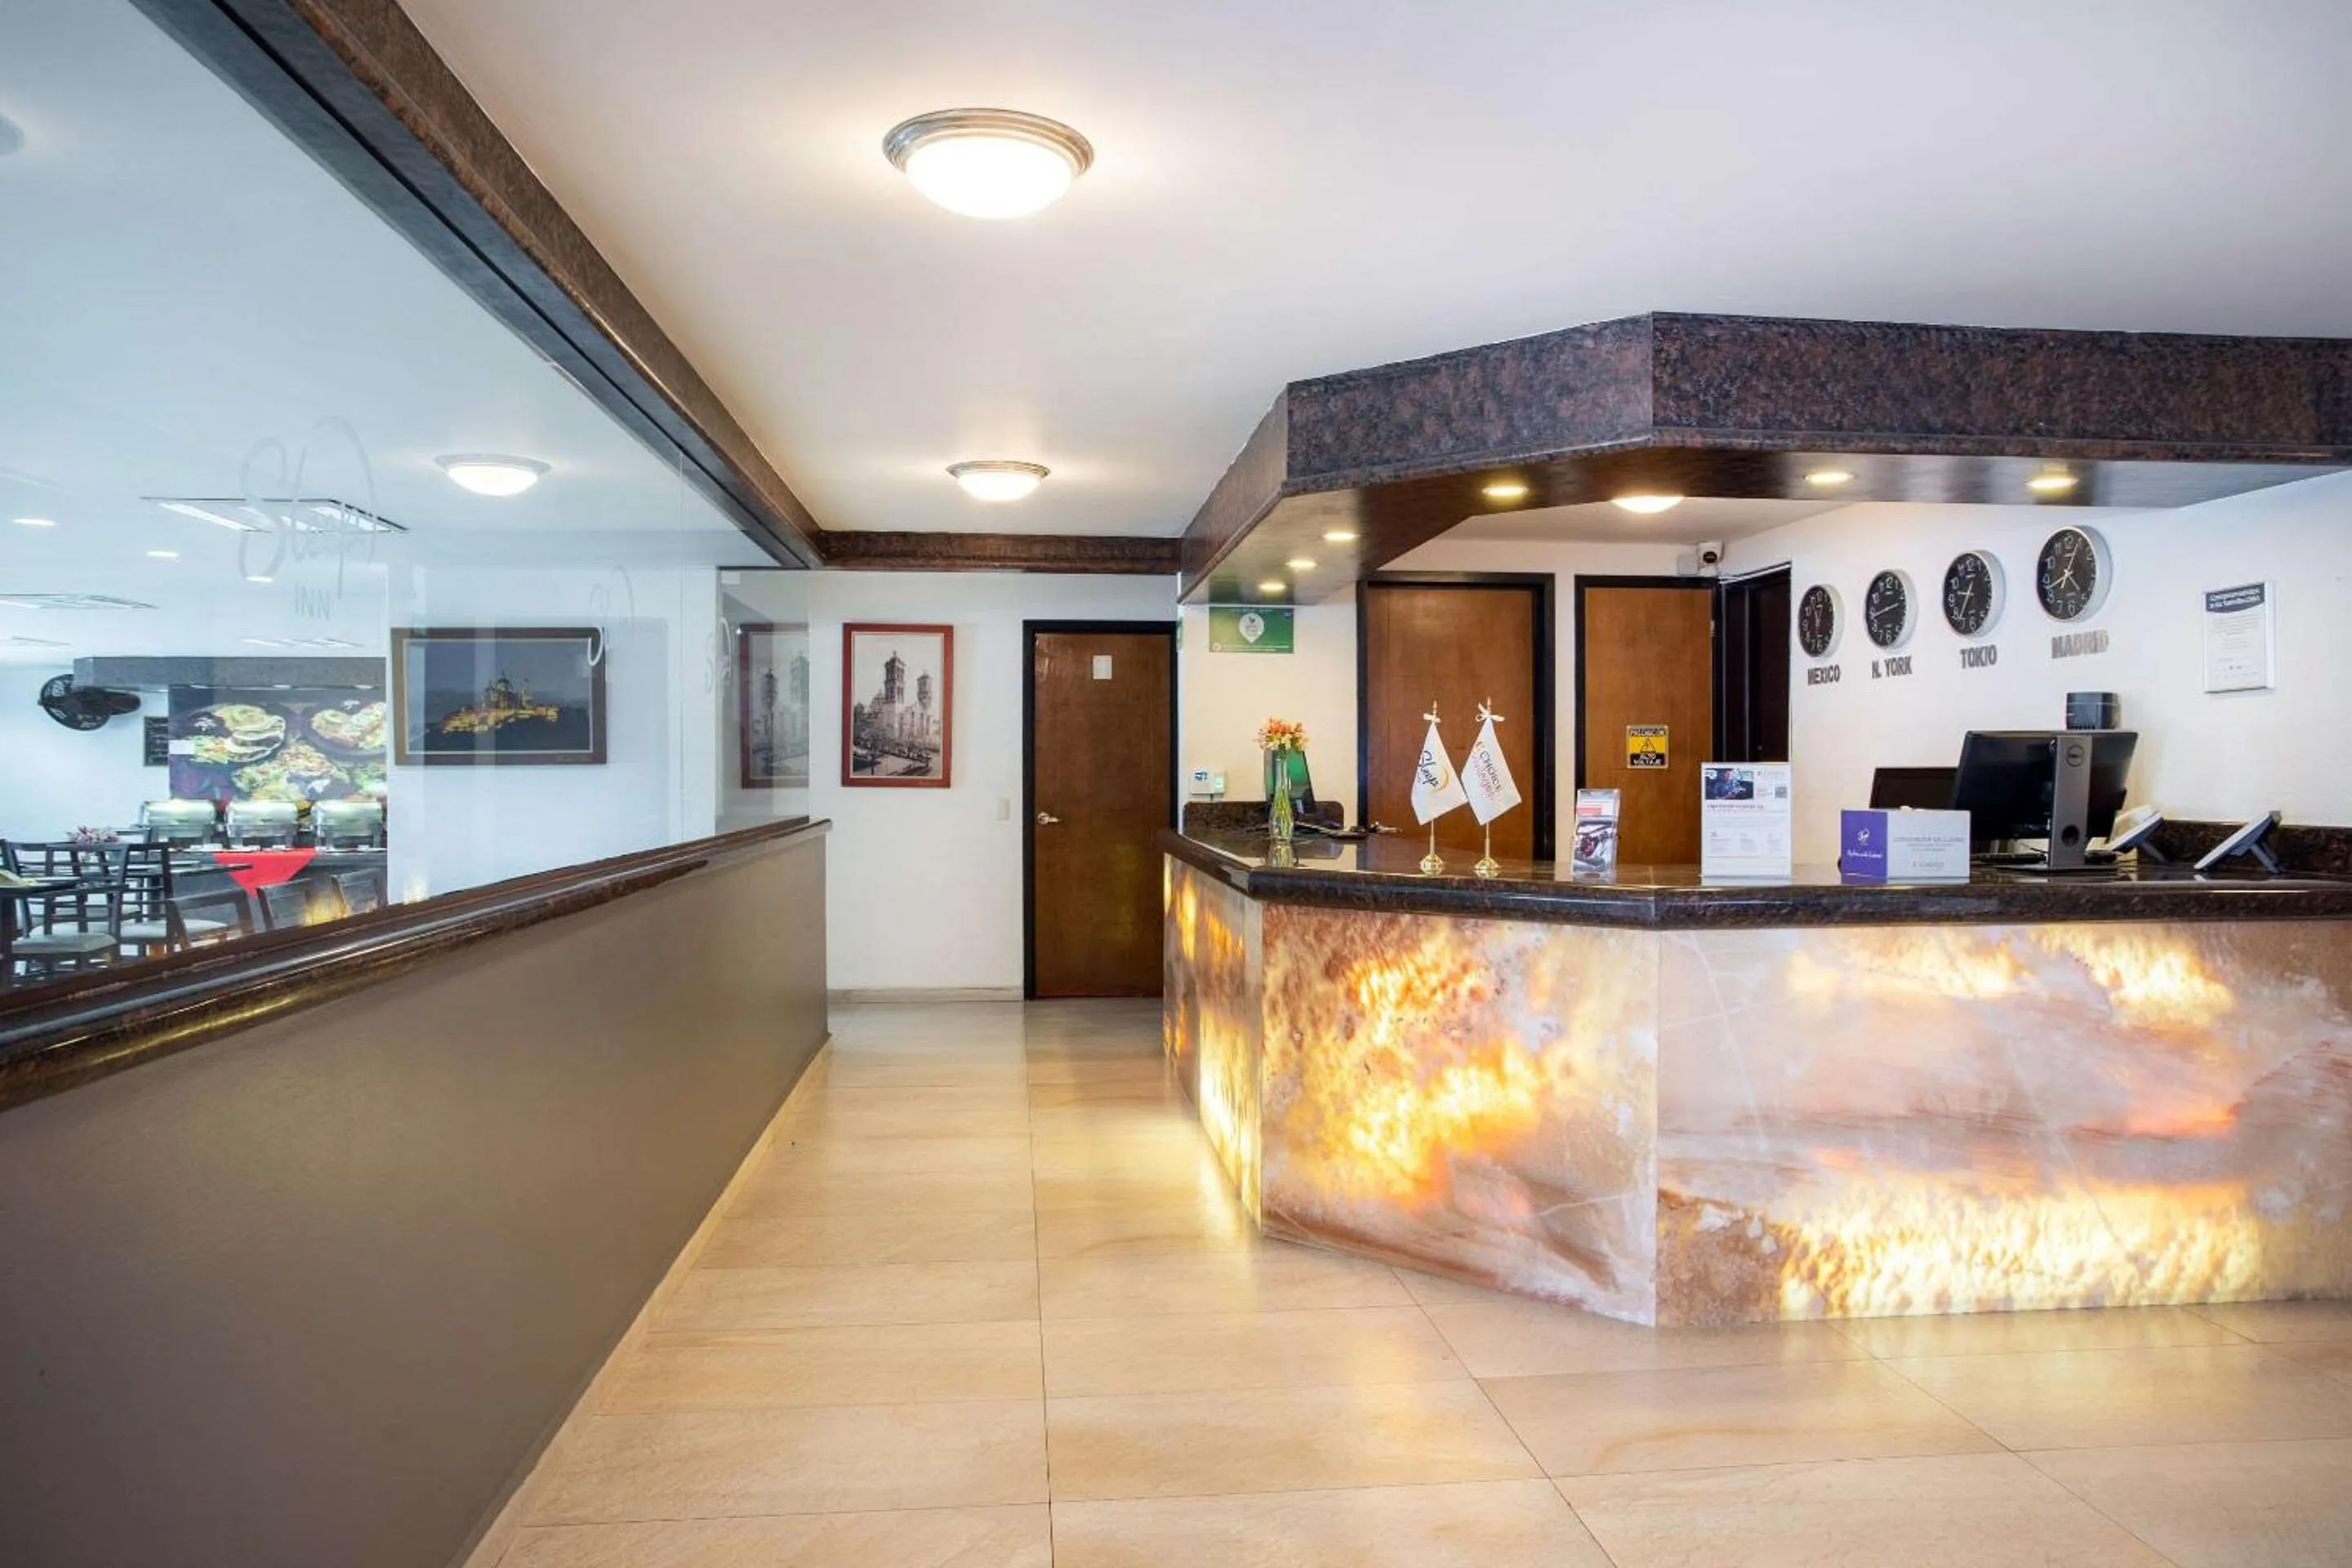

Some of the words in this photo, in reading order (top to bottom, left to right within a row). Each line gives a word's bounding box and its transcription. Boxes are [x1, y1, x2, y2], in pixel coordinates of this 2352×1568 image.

[2051, 629, 2109, 659] MADRID
[1872, 660, 1882, 679] N.
[1884, 655, 1913, 677] YORK
[1959, 644, 1998, 669] TOKIO
[1807, 664, 1841, 685] MEXICO
